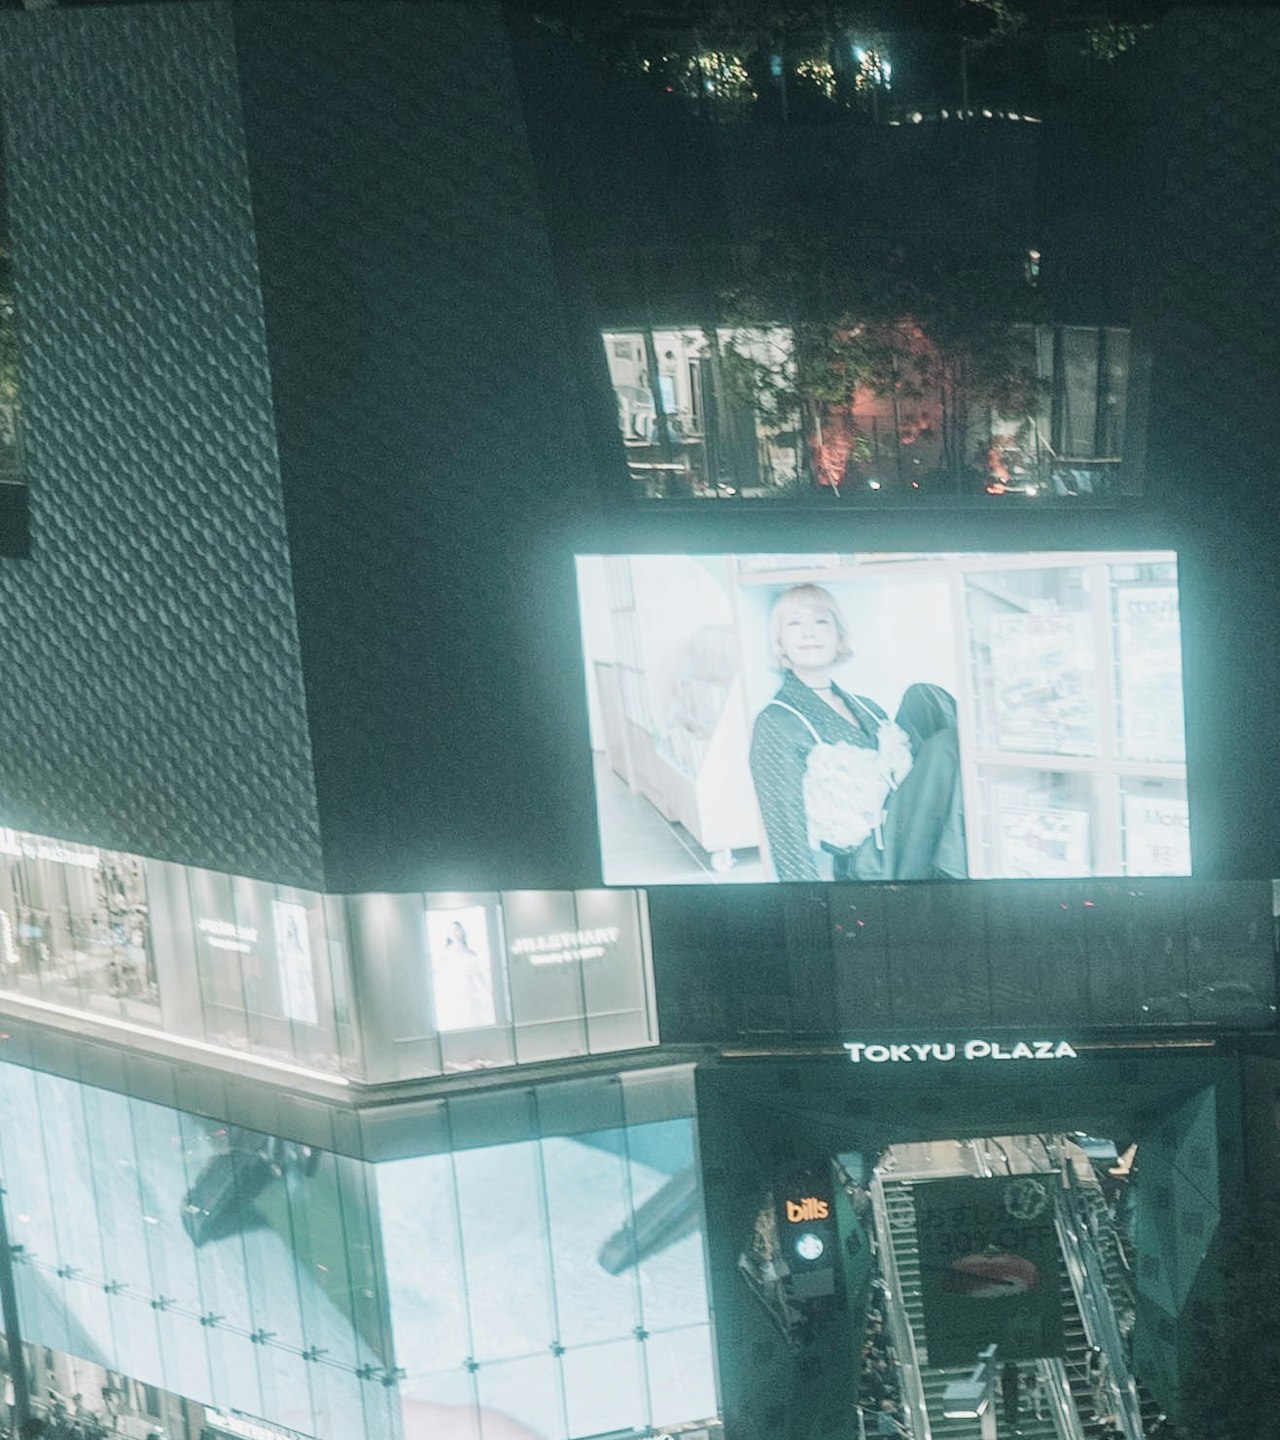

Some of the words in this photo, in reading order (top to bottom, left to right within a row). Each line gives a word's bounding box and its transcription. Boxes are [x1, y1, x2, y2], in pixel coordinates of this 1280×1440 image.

[843, 1042, 956, 1062] TOKYU
[964, 1039, 1078, 1060] PLAZA
[786, 1197, 829, 1223] bills
